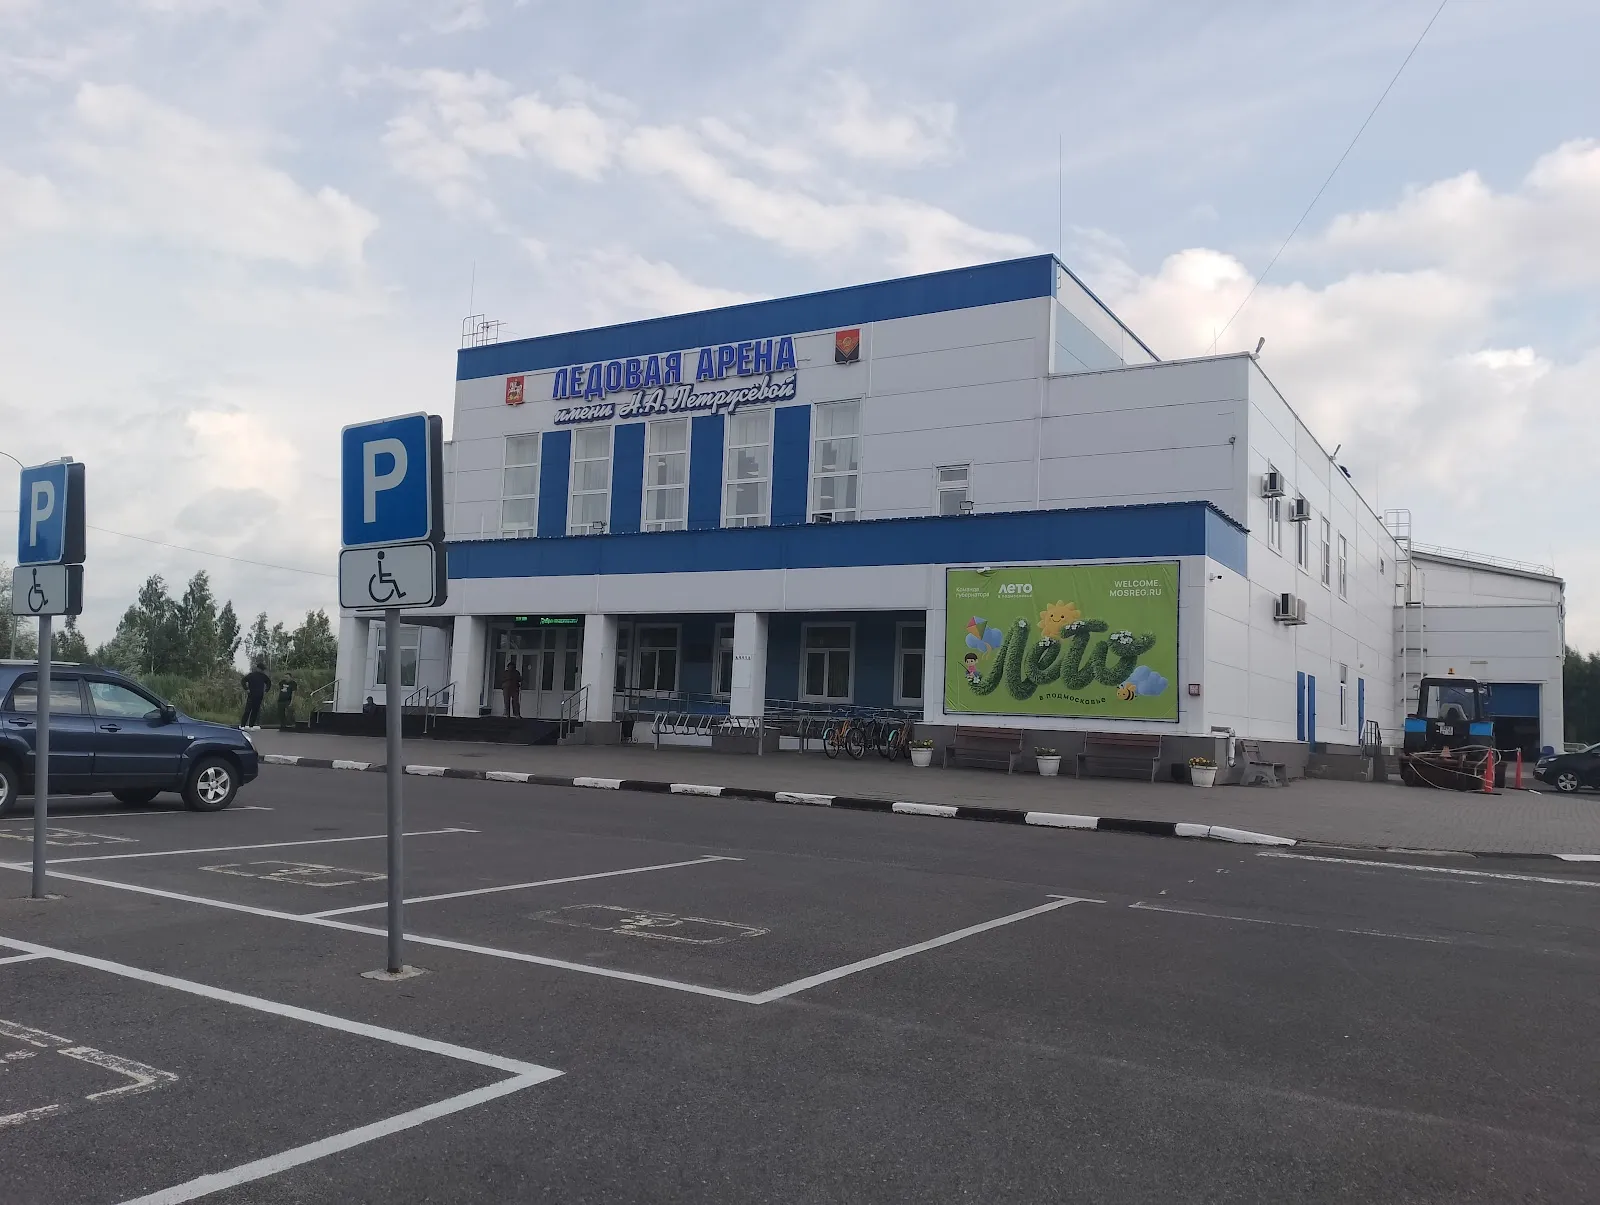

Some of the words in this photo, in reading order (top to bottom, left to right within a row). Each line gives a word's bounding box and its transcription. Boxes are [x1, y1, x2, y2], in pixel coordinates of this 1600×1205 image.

[552, 351, 682, 400] ЛЕДОВАЯ
[696, 336, 798, 381] АРЕНА
[554, 404, 614, 423] имени
[363, 438, 408, 524] P
[29, 481, 55, 547] P
[1109, 588, 1162, 597] MOSREG.RU
[1114, 579, 1162, 589] WELCOME.
